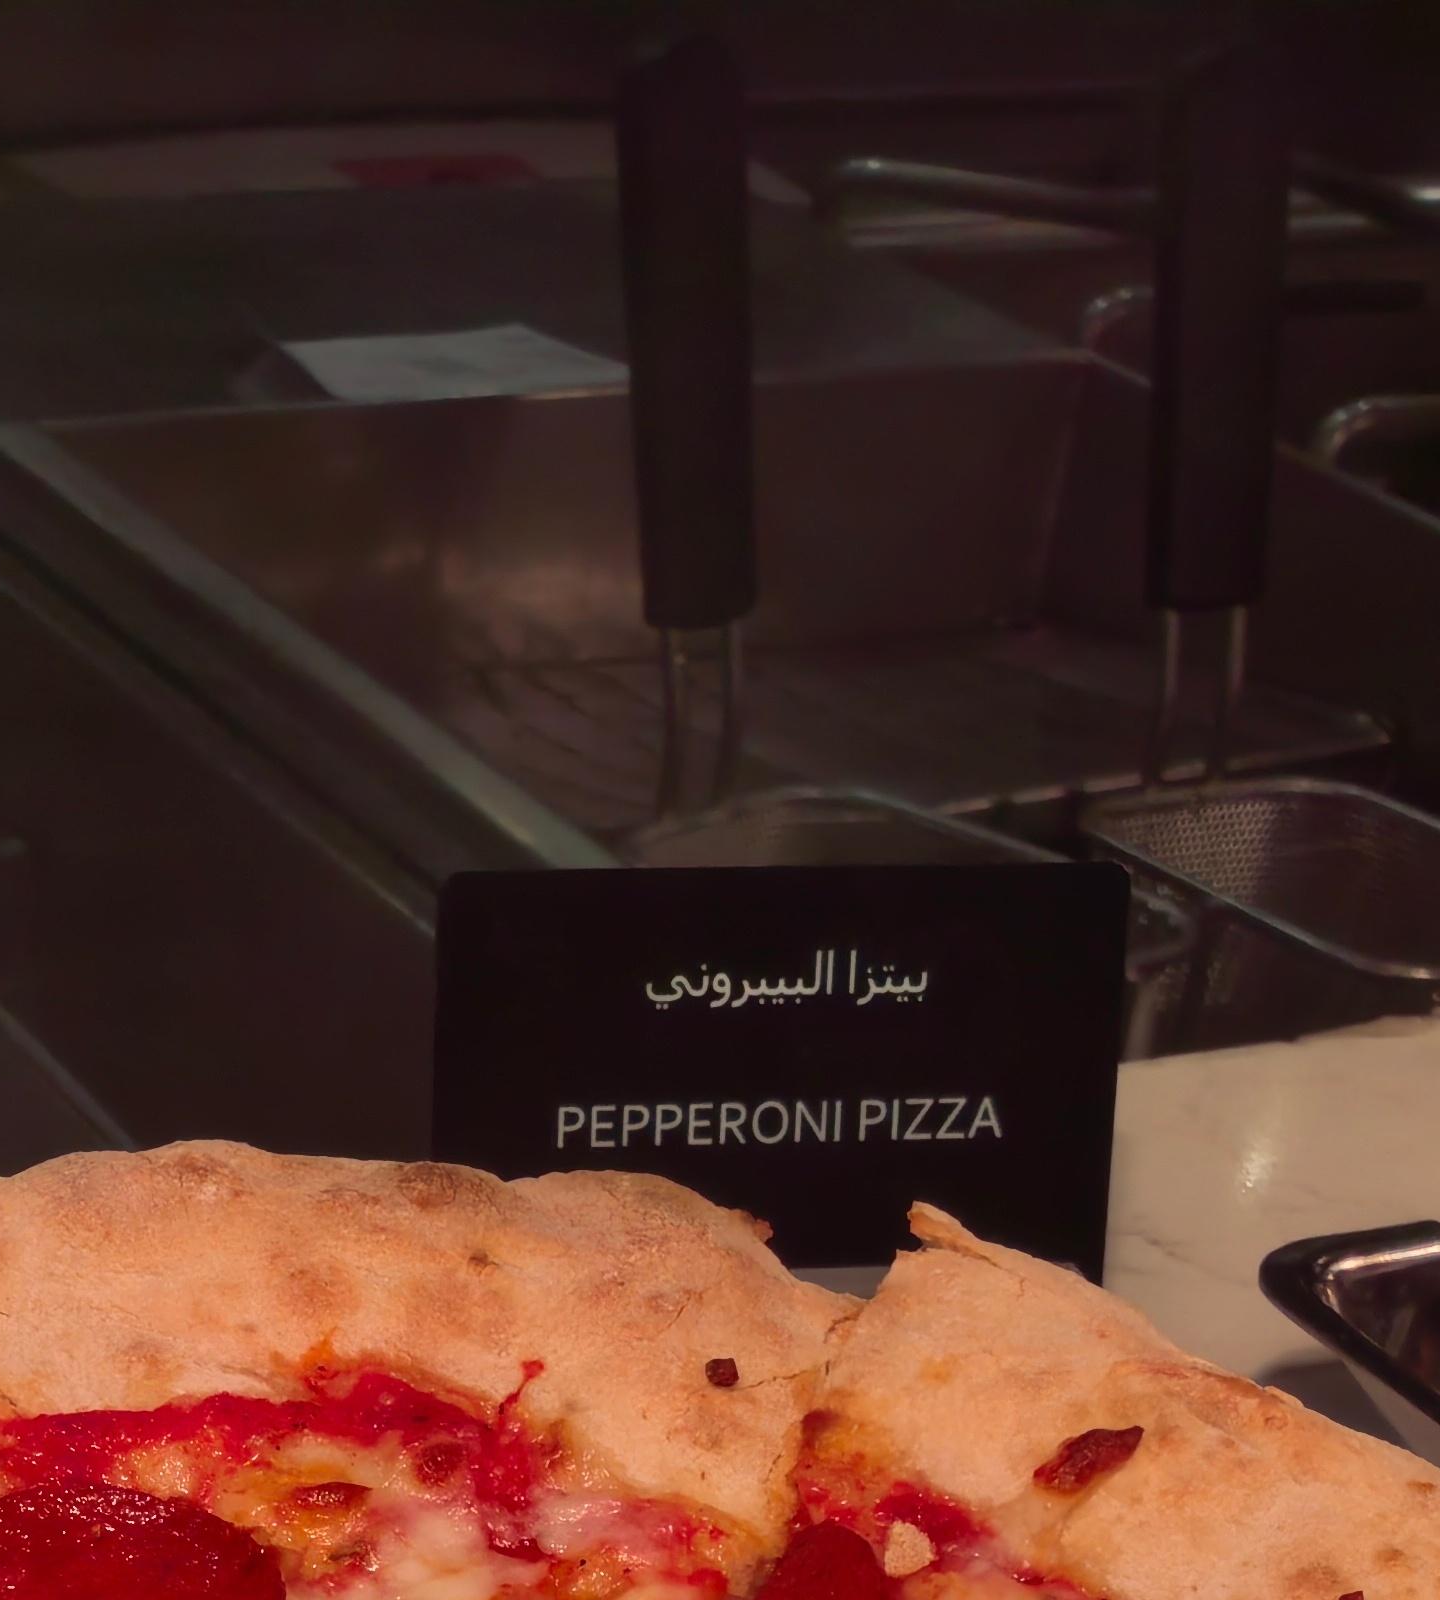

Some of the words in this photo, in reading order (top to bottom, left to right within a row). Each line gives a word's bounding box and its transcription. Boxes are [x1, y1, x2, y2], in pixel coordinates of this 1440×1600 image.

[645, 950, 834, 1010] البيبروني
[848, 950, 928, 1006] بيتزا
[556, 1099, 842, 1149] PEPPERONI
[858, 1097, 1002, 1142] PIZZA
